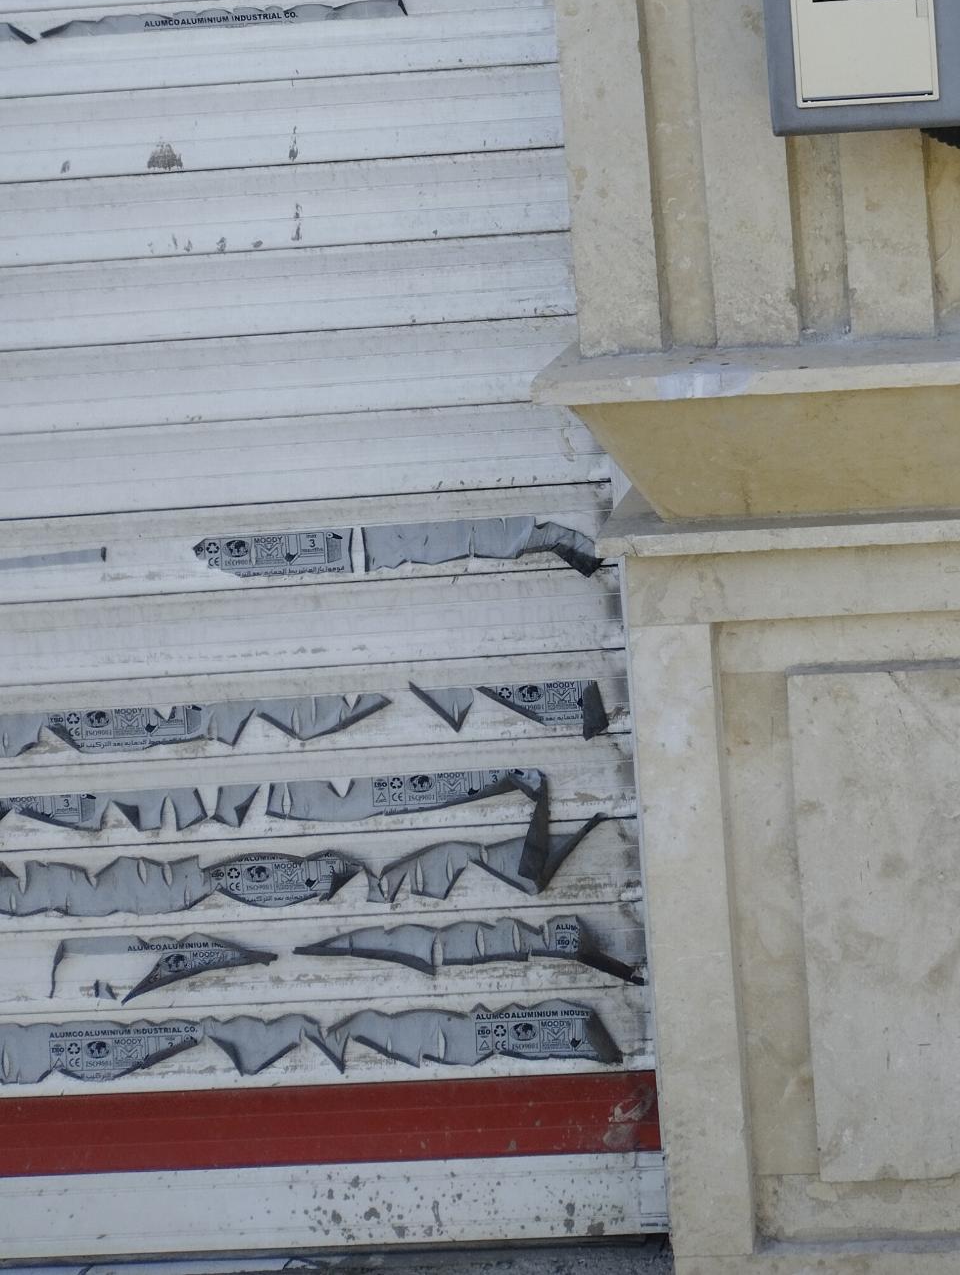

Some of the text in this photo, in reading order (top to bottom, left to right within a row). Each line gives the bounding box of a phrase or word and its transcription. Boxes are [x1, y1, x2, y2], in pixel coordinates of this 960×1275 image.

[144, 11, 299, 28] ALUMCO ALUMINIUM INDUSTRIAL CO.
[253, 536, 283, 544] MOODY
[309, 539, 316, 548] 3
[546, 681, 575, 689] MOODY
[114, 707, 143, 715] MOODY
[491, 774, 499, 784] 3
[392, 792, 403, 802] CE
[63, 798, 70, 808] 3
[229, 882, 240, 891] CE
[127, 944, 161, 952] ALUMCO
[162, 941, 211, 950] ALUMINIUM
[475, 1012, 511, 1020] ALUMCO
[511, 1009, 559, 1019] ALUMINIUM
[50, 1026, 198, 1039] ALUMCO ALUMINIUM INDUSTRIAL CO.
[495, 1040, 507, 1050] CE
[68, 1057, 80, 1067] CE
